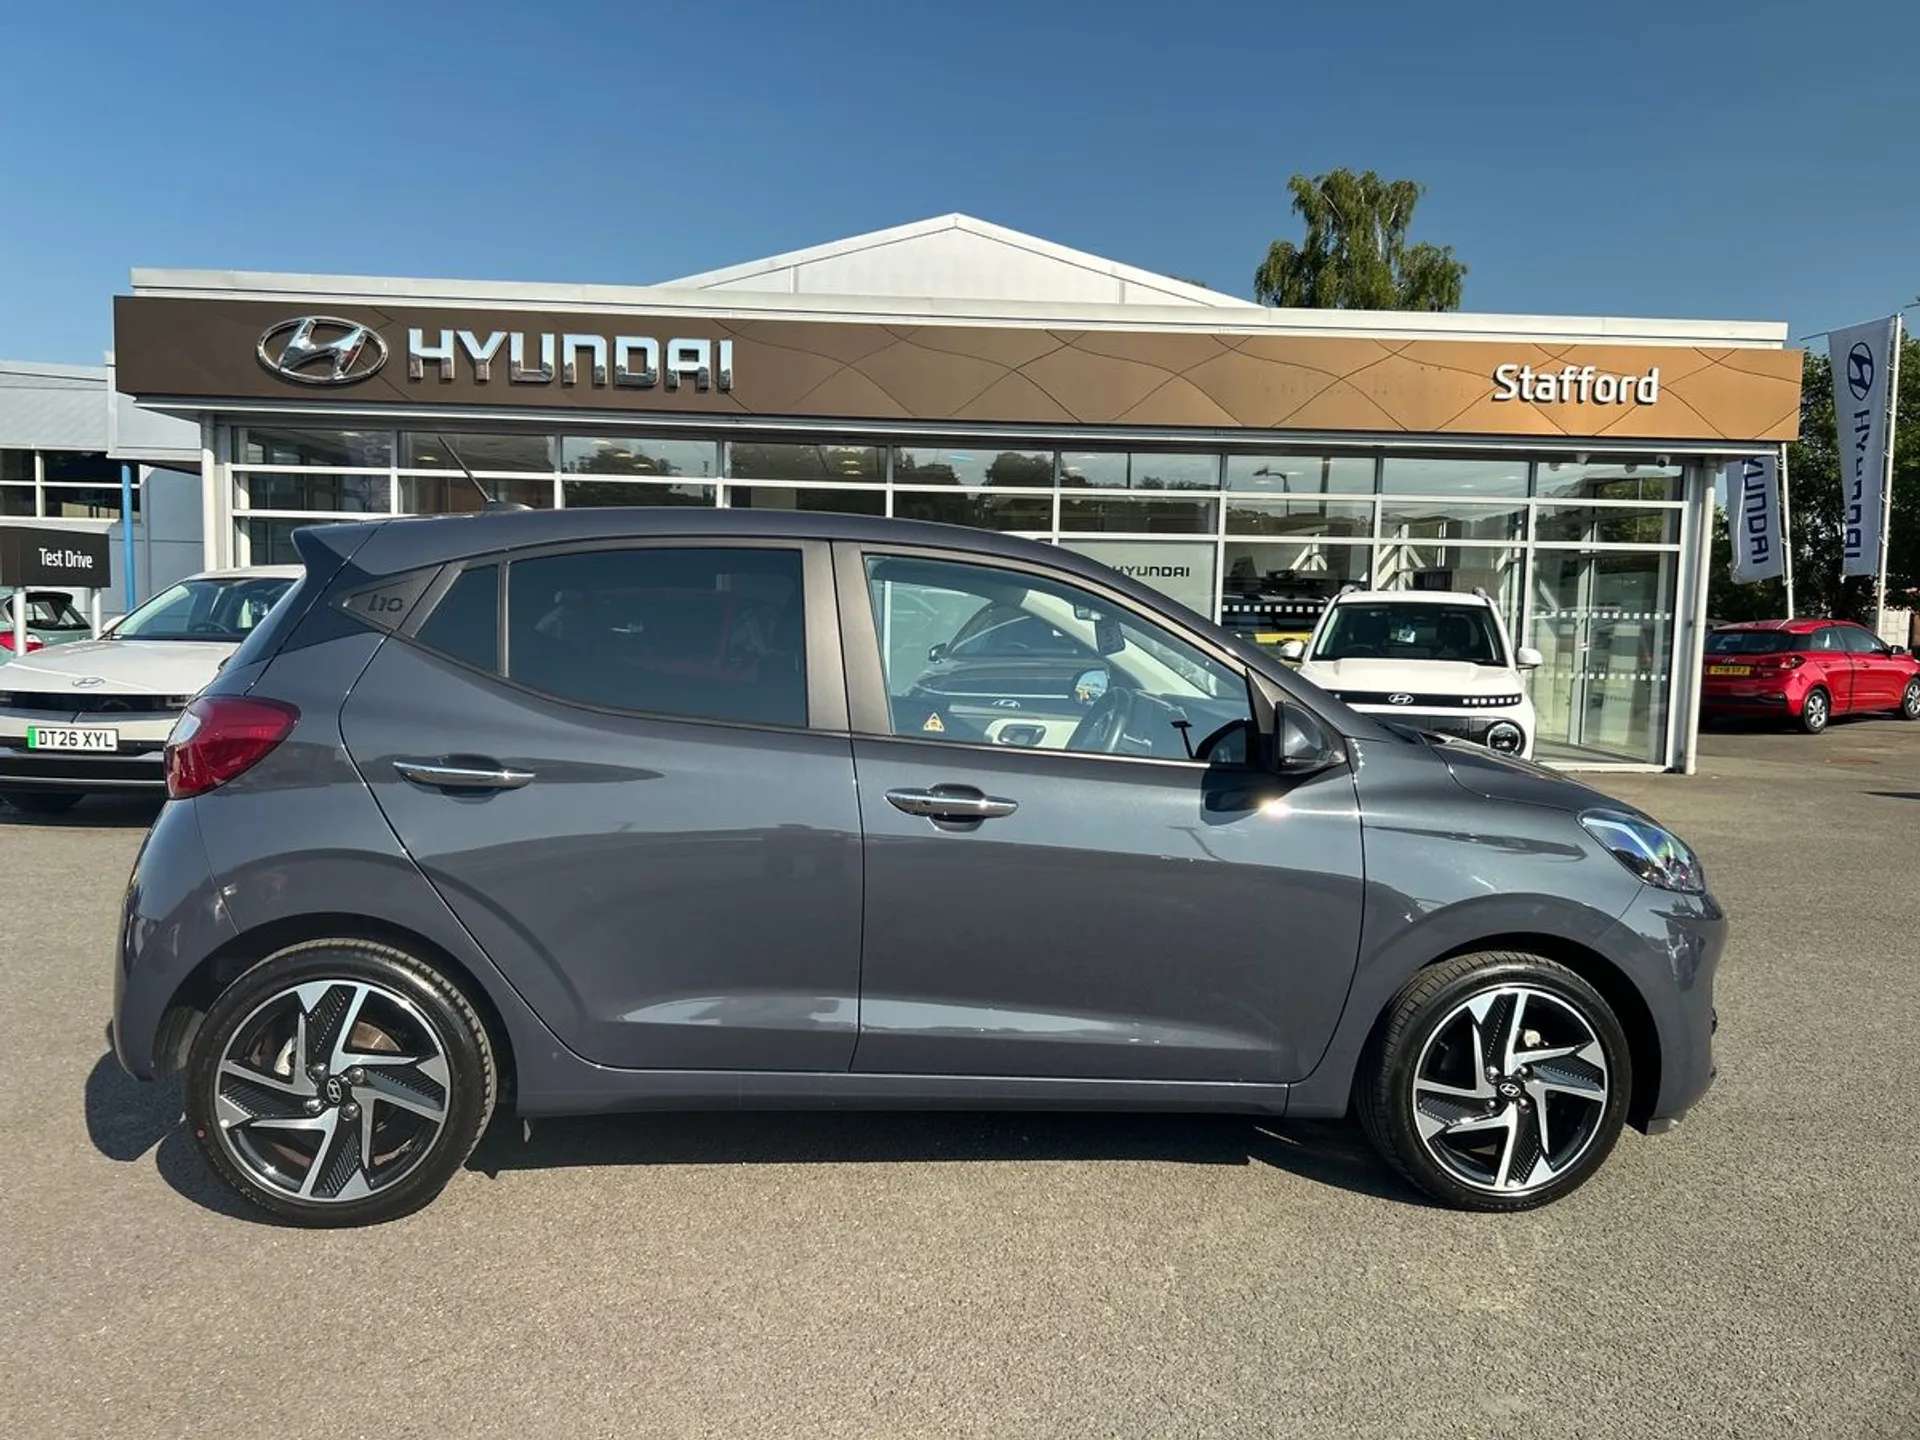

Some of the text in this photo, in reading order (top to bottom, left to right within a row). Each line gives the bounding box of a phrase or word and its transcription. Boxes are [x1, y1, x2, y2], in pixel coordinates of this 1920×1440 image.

[408, 327, 734, 391] HYUNDAI
[1493, 363, 1660, 405] Stafford
[1743, 454, 1769, 564] YUNDAI
[39, 548, 93, 569] Test Drive
[38, 730, 114, 747] DT26 XYL
